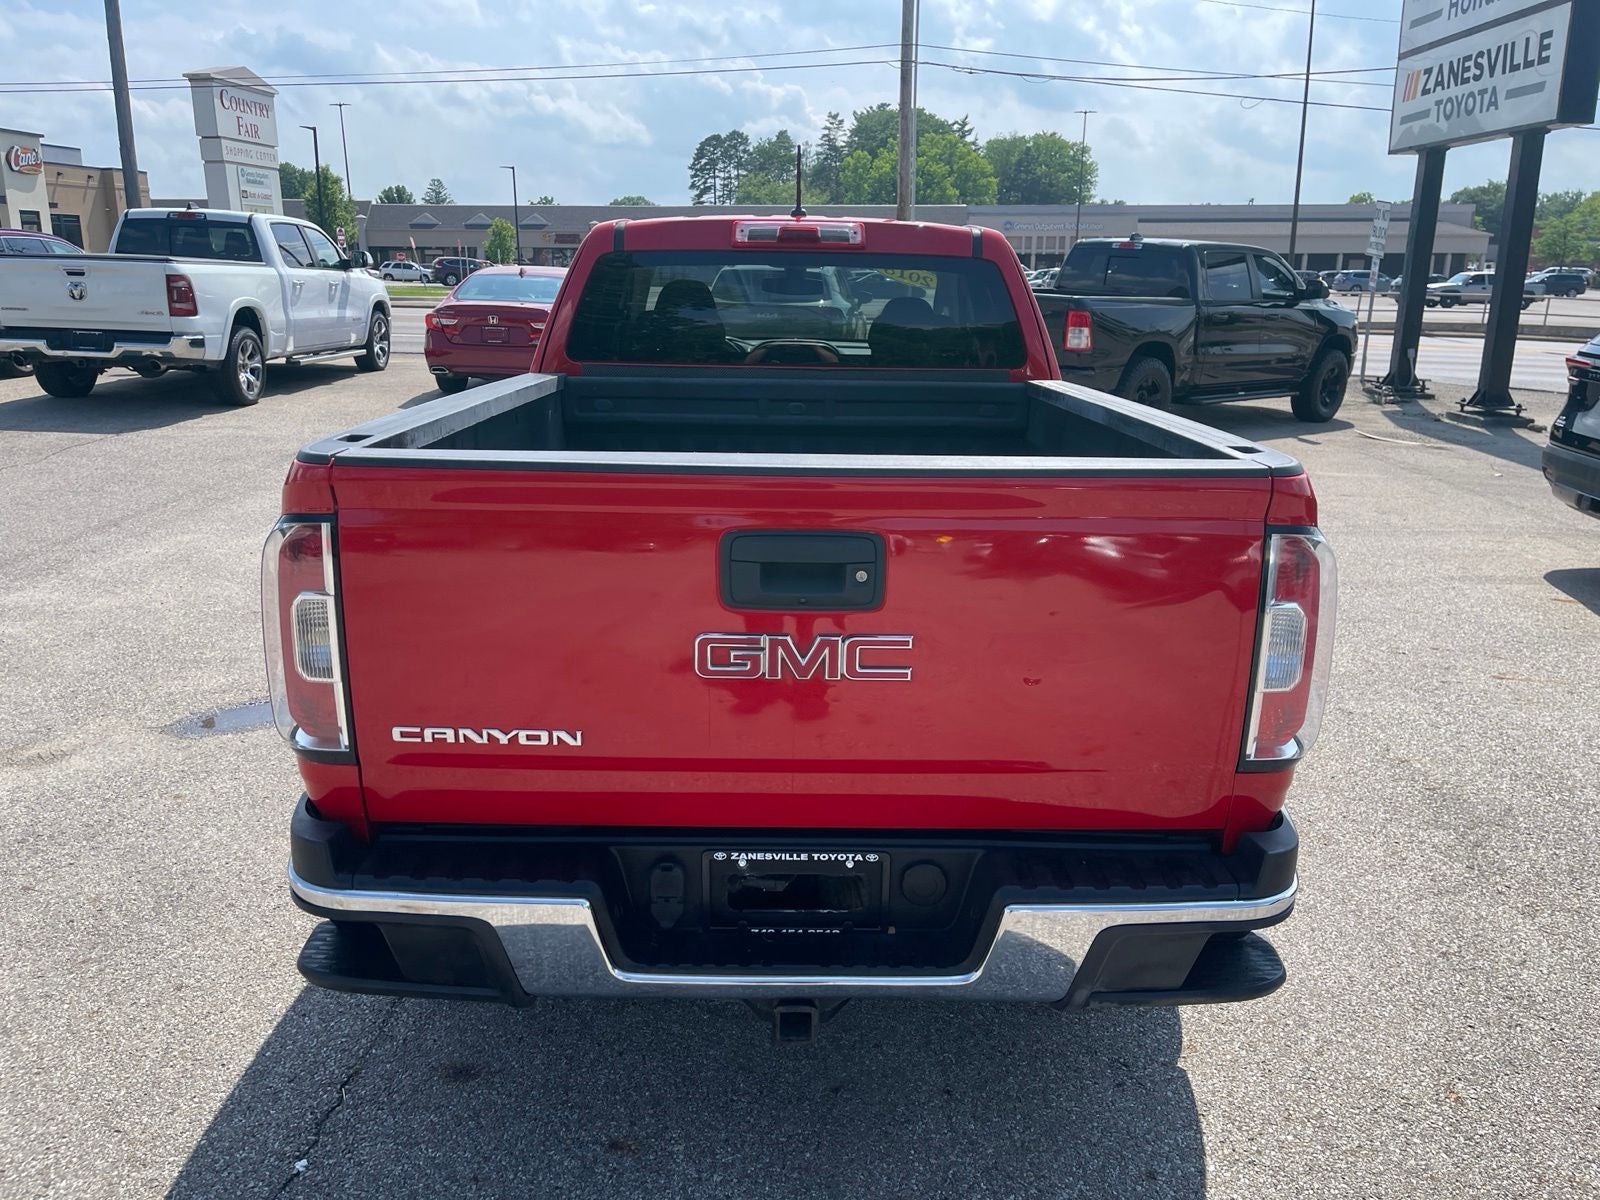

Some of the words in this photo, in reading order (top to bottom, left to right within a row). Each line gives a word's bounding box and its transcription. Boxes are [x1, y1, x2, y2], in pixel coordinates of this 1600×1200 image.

[1447, 0, 1500, 20] Hon
[1420, 29, 1554, 97] ZANESVILLE
[220, 88, 270, 119] COUNTRY
[1434, 85, 1499, 123] TOYOTA
[236, 116, 260, 140] FAIR
[694, 633, 913, 681] GMC
[391, 726, 582, 746] CANYON
[730, 852, 808, 861] ZANESVILLE
[812, 853, 863, 862] TOYOTA
